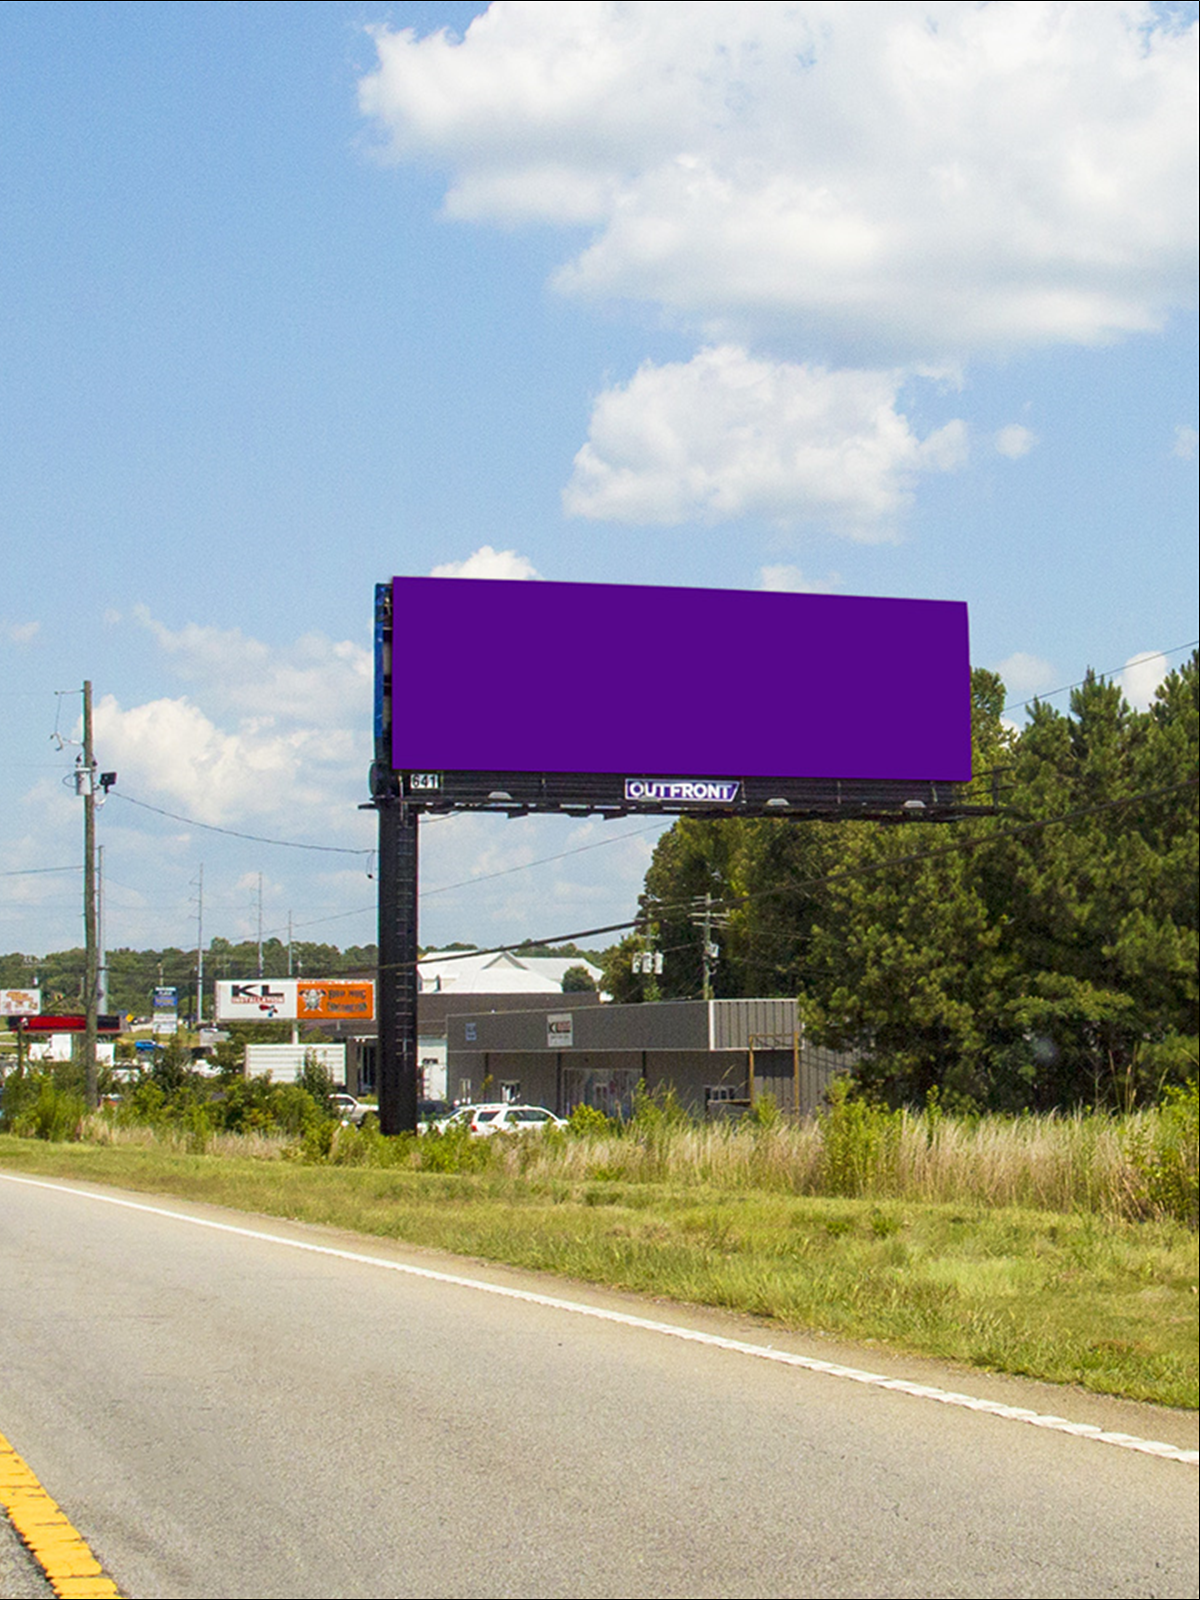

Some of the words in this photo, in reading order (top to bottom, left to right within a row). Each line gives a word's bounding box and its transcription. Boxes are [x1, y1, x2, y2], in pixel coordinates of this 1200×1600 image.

[412, 774, 437, 788] 641
[629, 782, 733, 799] OUTFRONT
[231, 984, 285, 997] KL
